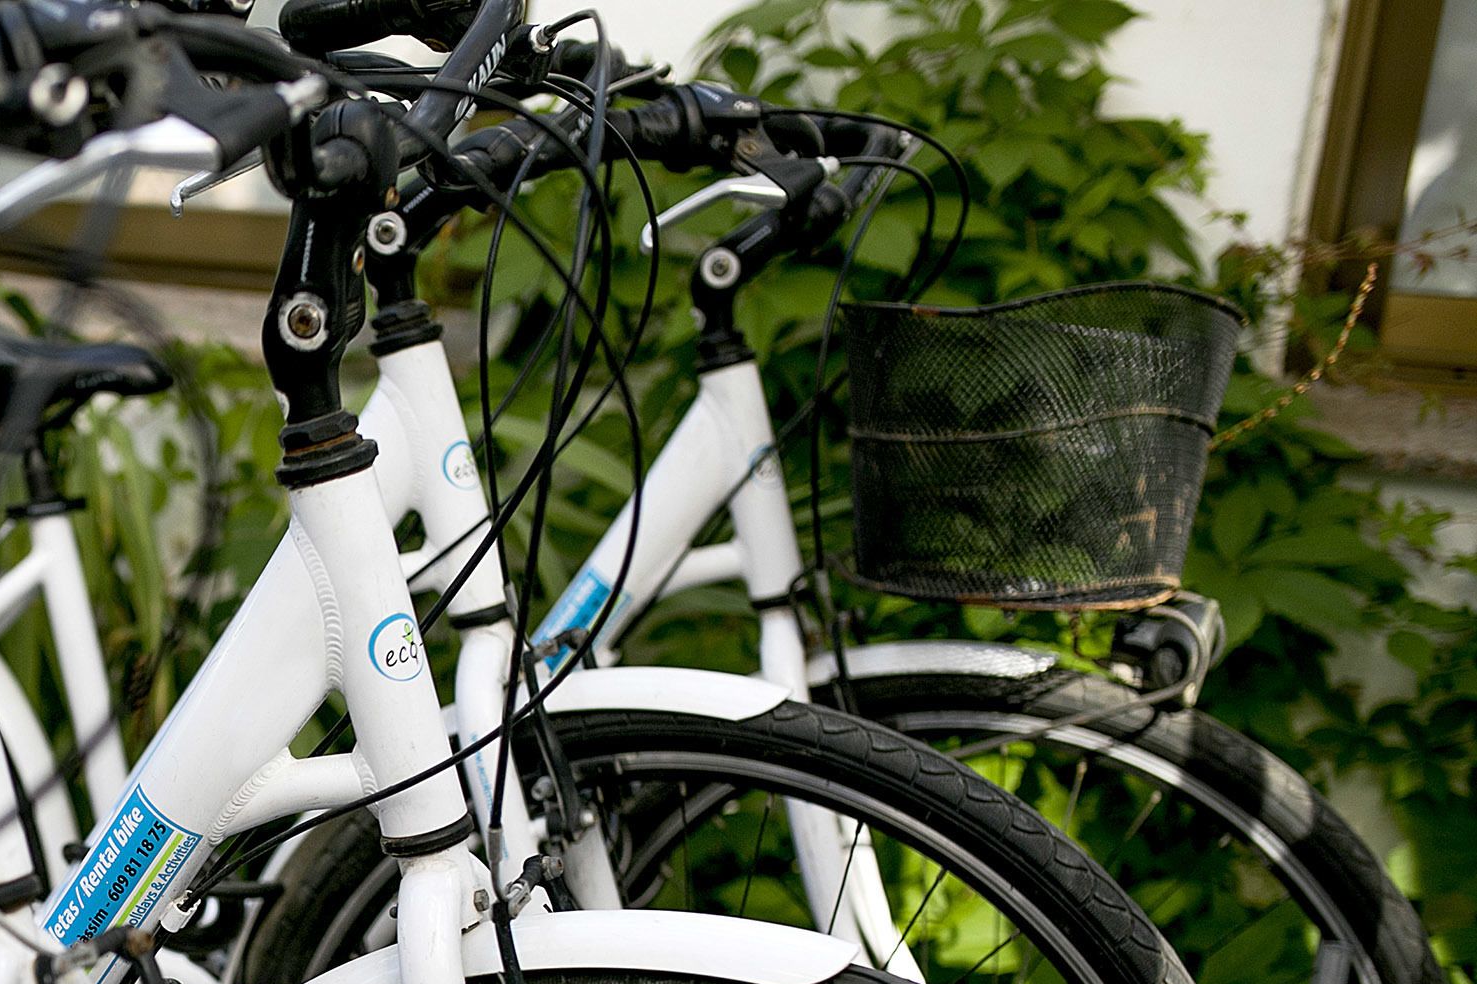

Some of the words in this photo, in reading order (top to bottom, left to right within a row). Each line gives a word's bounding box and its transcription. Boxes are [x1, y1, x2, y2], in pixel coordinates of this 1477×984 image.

[48, 899, 80, 942] letas
[79, 836, 121, 898] Rental
[112, 806, 145, 853] bike
[108, 874, 129, 902] 609
[124, 857, 142, 877] 81
[136, 839, 154, 857] 18
[148, 820, 167, 842] 75
[128, 890, 158, 928] olidays
[151, 881, 164, 891] &
[158, 835, 198, 882] Activities
